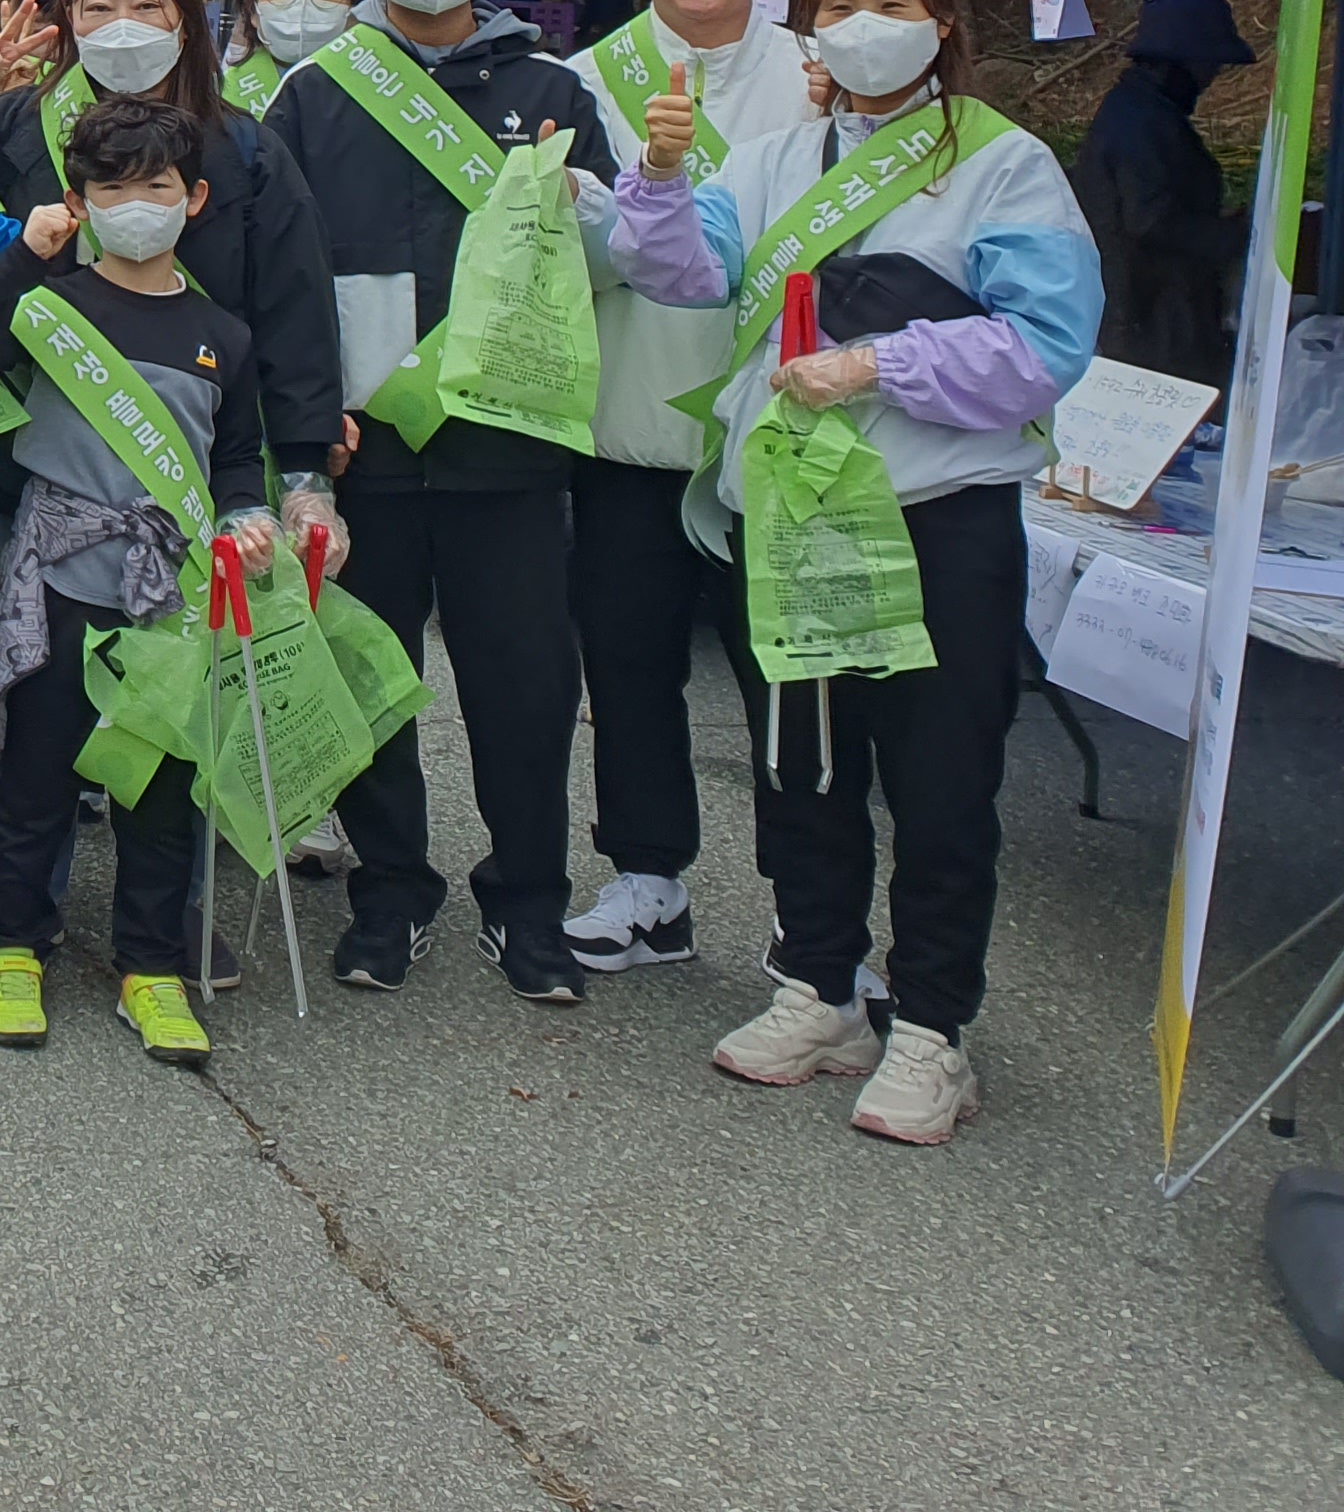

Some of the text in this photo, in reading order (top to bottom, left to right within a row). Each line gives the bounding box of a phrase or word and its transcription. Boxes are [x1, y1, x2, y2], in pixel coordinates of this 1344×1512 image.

[399, 92, 461, 152] 내가
[609, 29, 650, 86] 재생
[737, 128, 937, 327] 도시재생 플로킹
[22, 298, 216, 550] 시재생 플로킹 캠페
